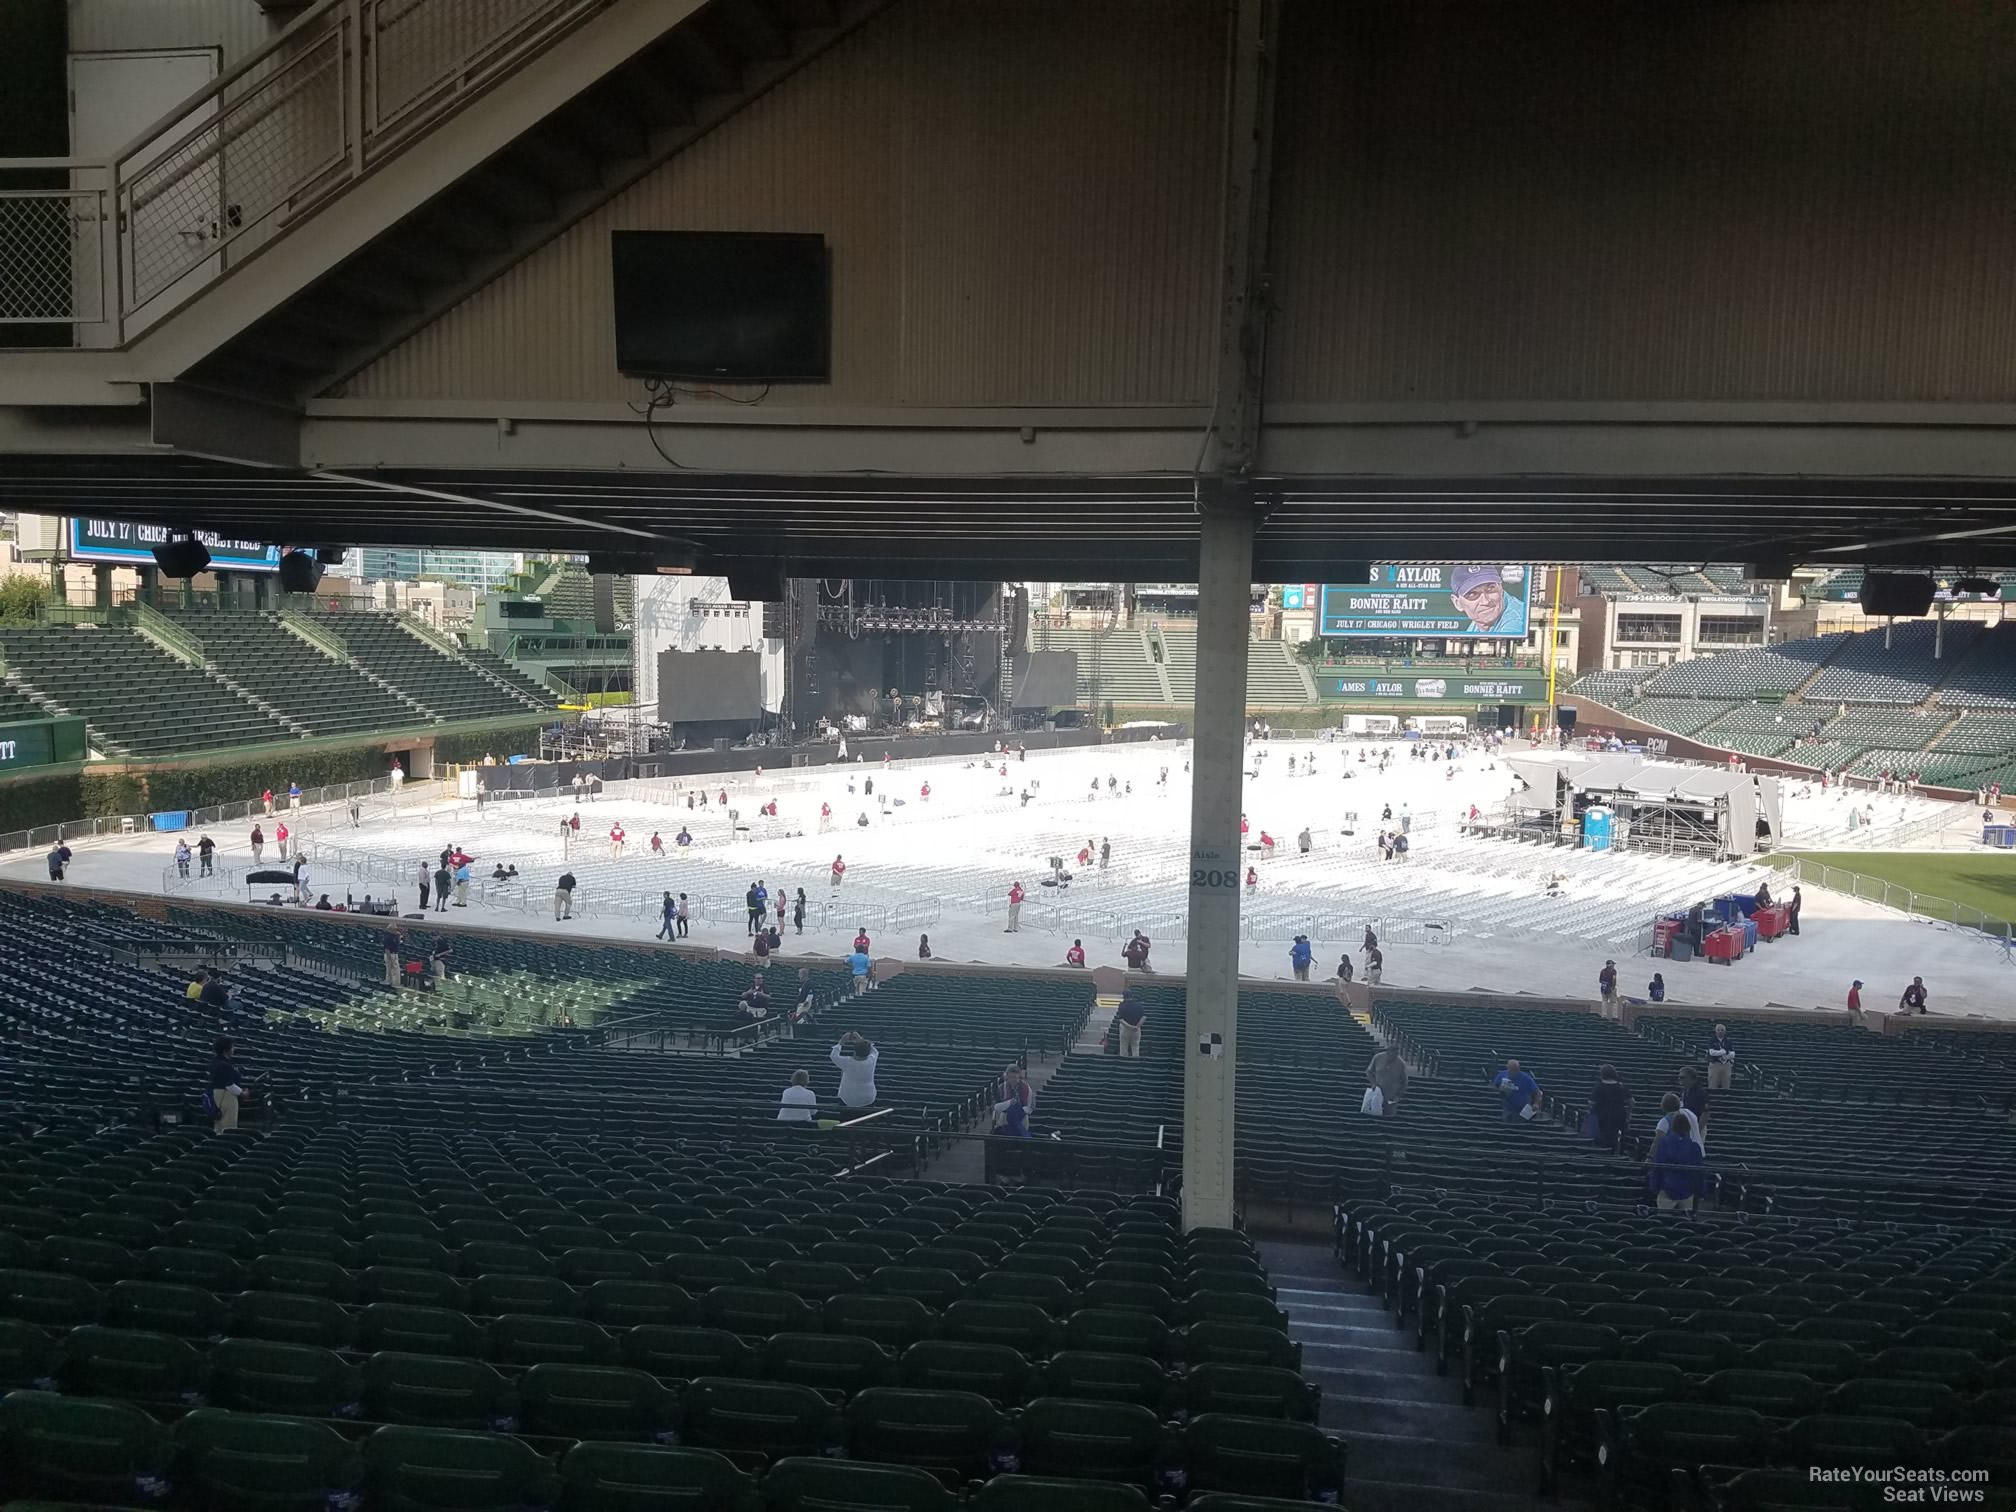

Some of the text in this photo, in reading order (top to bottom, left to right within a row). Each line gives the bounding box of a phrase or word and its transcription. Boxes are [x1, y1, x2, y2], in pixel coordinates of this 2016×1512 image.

[87, 519, 115, 538] JULY
[119, 522, 130, 539] 17
[1350, 598, 1428, 610] BONNIE RAITT
[1336, 620, 1459, 629] JULY 17 CHICAGO WRIGLEY FIELD
[1337, 679, 1365, 692] JAMES
[1368, 679, 1403, 692] TAYLOR
[1463, 685, 1523, 694] BONNIE RAITT
[1193, 851, 1220, 859] Aisle
[1192, 869, 1238, 888] 208
